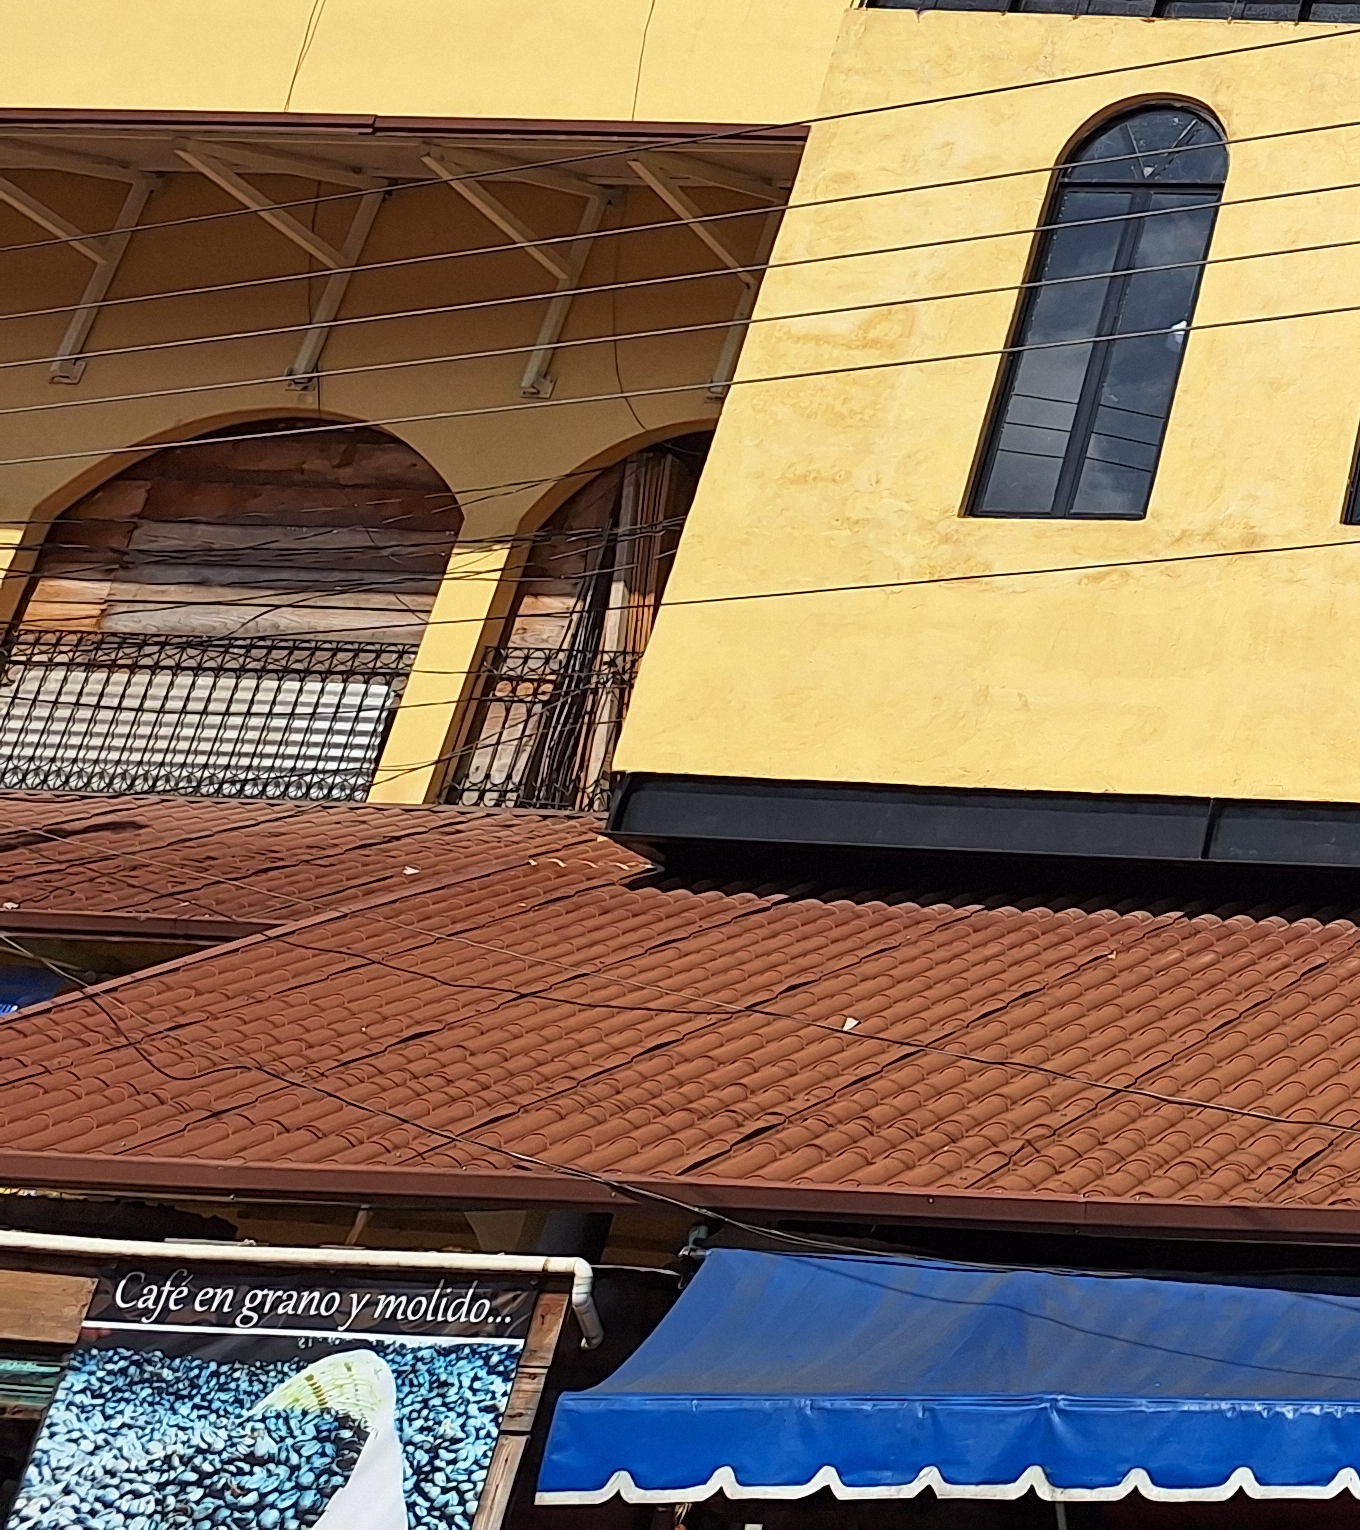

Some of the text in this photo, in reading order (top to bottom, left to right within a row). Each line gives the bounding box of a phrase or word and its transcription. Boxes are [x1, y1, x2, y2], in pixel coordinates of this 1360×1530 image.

[115, 1268, 514, 1331] Café en grano y molido...
